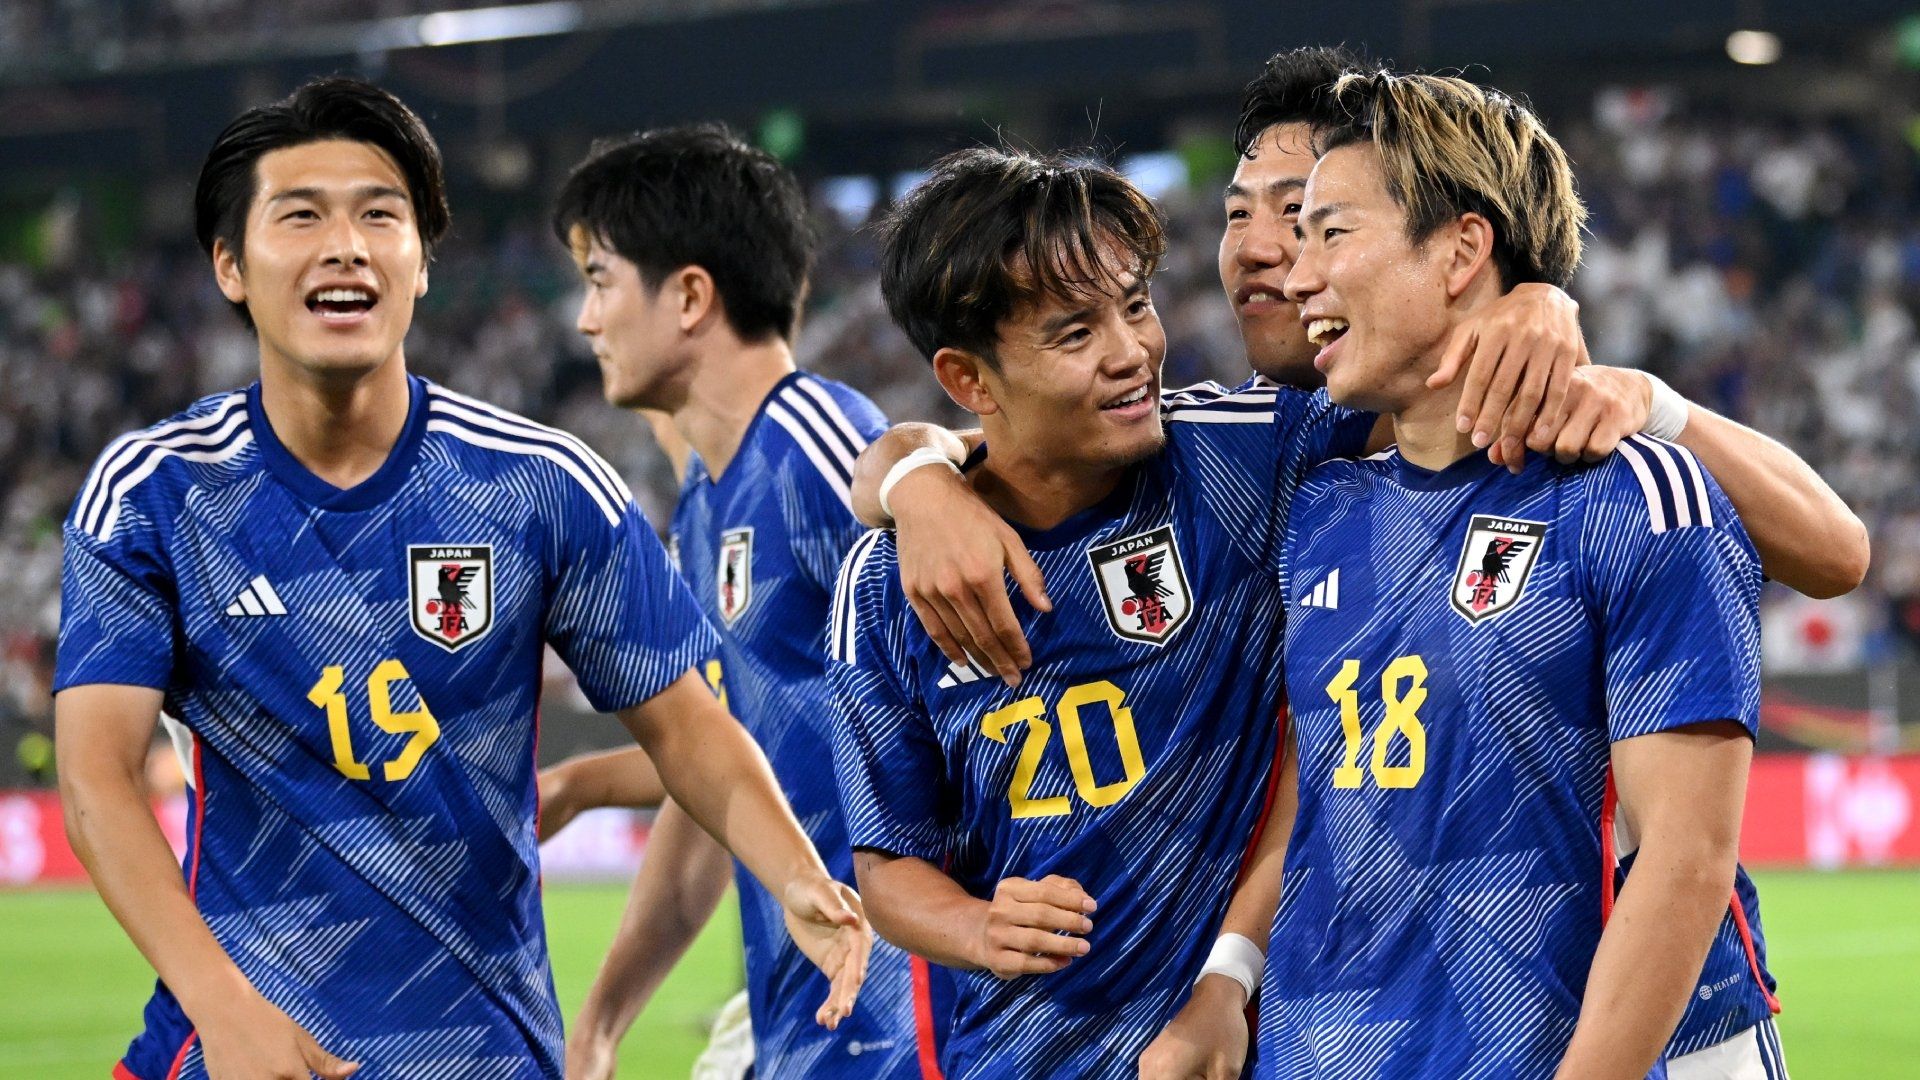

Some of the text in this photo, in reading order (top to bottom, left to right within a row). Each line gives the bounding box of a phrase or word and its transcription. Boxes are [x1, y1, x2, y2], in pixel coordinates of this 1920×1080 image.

[1487, 520, 1530, 533] JAPAN
[429, 549, 472, 559] JAPAN
[1111, 536, 1154, 557] JAPAN
[1466, 588, 1497, 605] JFA
[434, 616, 469, 632] JFA
[1136, 605, 1174, 631] JFA
[306, 658, 441, 782] 19
[1325, 654, 1429, 789] 18
[980, 680, 1146, 819] 20
